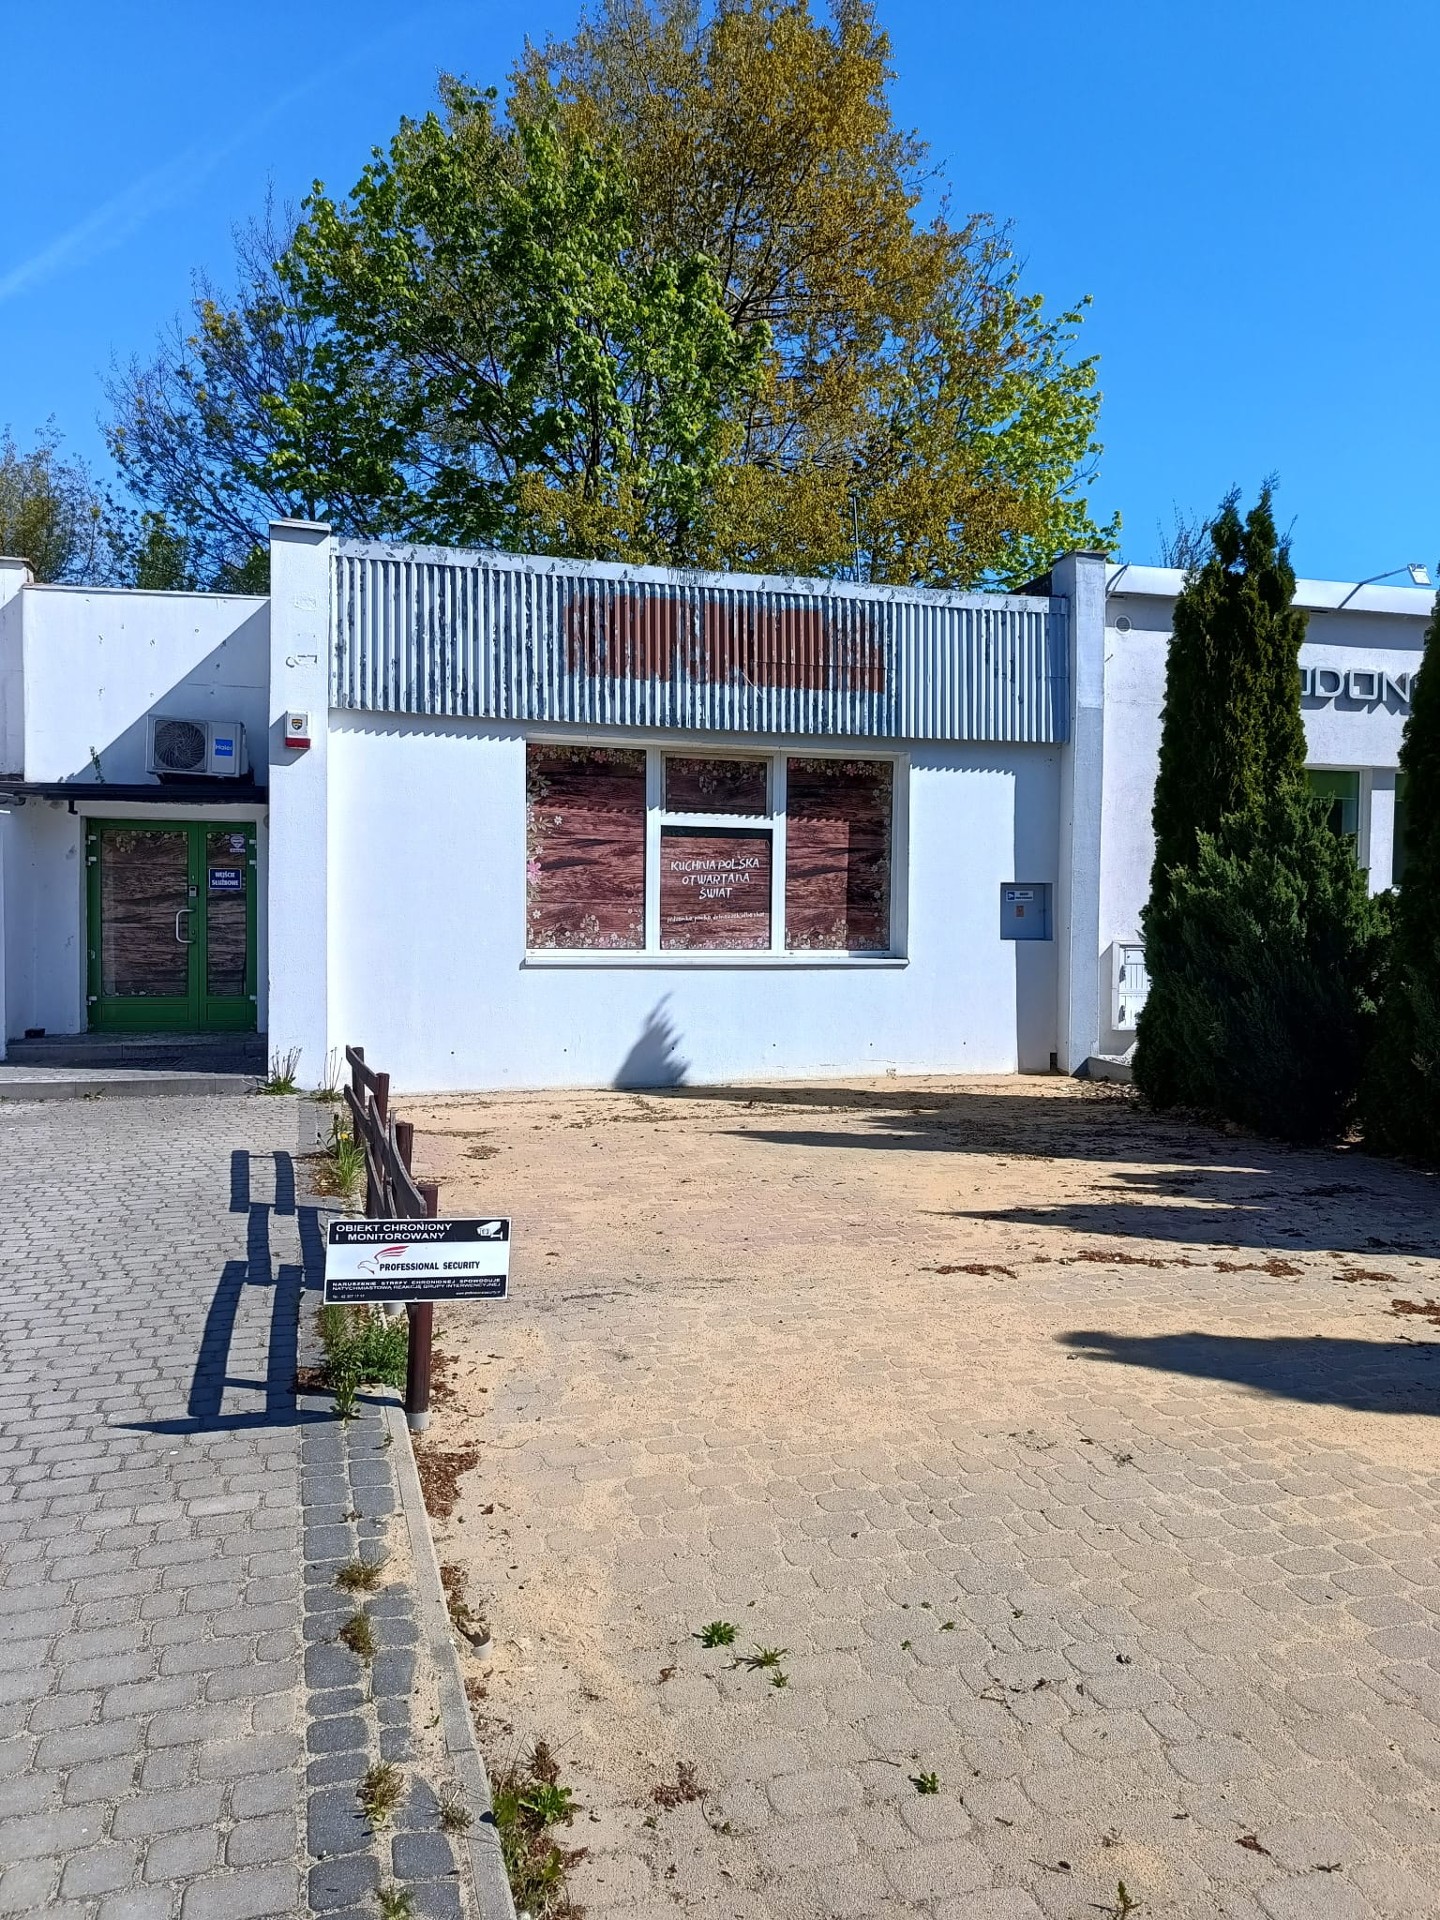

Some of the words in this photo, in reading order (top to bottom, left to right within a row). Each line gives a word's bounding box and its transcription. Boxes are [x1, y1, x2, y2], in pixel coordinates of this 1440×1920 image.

[1300, 666, 1416, 702] DON
[670, 860, 716, 871] KUCHNIA
[718, 857, 760, 869] POLSKA
[699, 887, 733, 900] ŚWIAT
[336, 1224, 380, 1232] OBIEKT
[383, 1223, 452, 1232] CHRONIONY
[348, 1232, 445, 1241] MONITOROWANY
[380, 1262, 439, 1271] PROFESSIONAL
[443, 1261, 480, 1270] SECURITY
